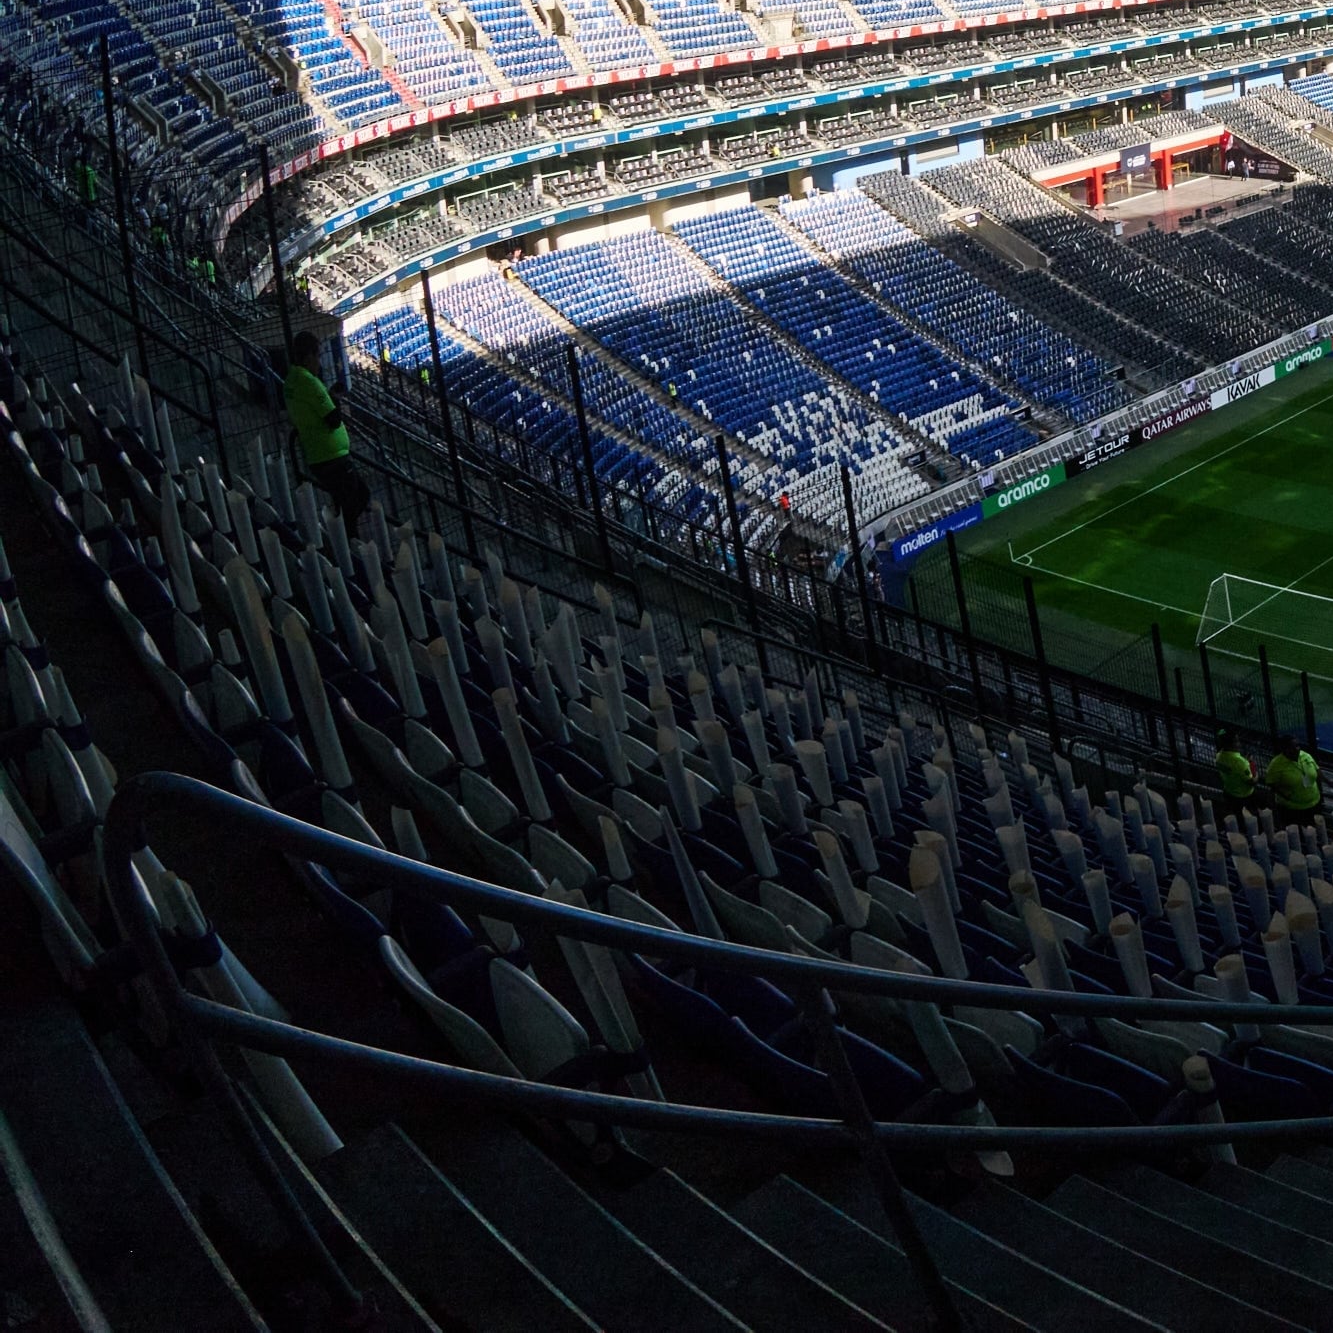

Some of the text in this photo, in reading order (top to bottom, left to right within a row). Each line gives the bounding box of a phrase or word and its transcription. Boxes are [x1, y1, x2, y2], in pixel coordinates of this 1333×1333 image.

[1285, 346, 1322, 372] aramco
[1228, 374, 1260, 401] KAVAK
[1142, 398, 1212, 441] QATAR AIRWAYS
[1079, 434, 1130, 465] JETOUR
[997, 473, 1050, 508] aramco
[900, 528, 938, 556] molten
